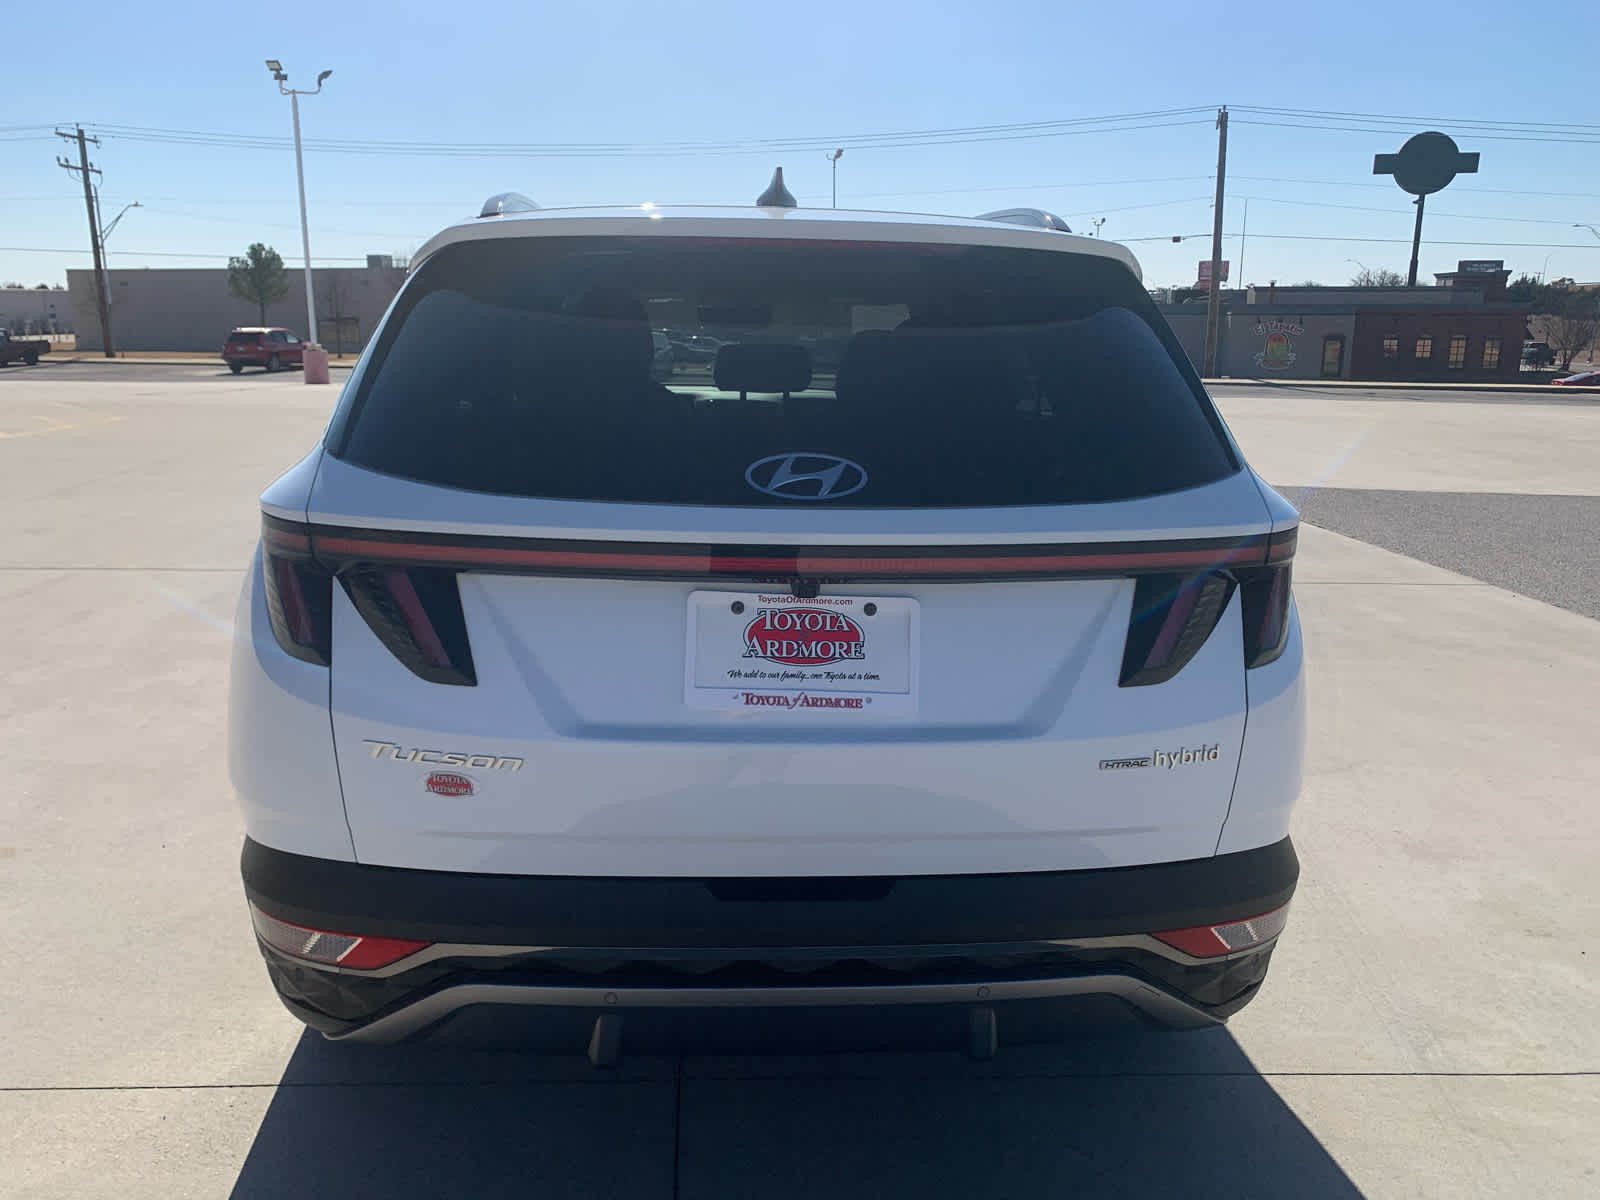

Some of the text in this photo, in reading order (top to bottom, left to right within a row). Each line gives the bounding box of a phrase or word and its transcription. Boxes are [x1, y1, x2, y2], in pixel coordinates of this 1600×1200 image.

[758, 594, 853, 605] ToyotaOfArdmore.com
[757, 608, 851, 631] TOYOTA
[742, 635, 865, 659] ARDMORE
[728, 669, 742, 679] We
[743, 669, 760, 679] add
[760, 671, 767, 679] to
[848, 672, 857, 680] at
[741, 692, 790, 706] TOYOTA
[799, 694, 863, 709] ARDMORE
[1103, 743, 1220, 769] HTRAC hybrid
